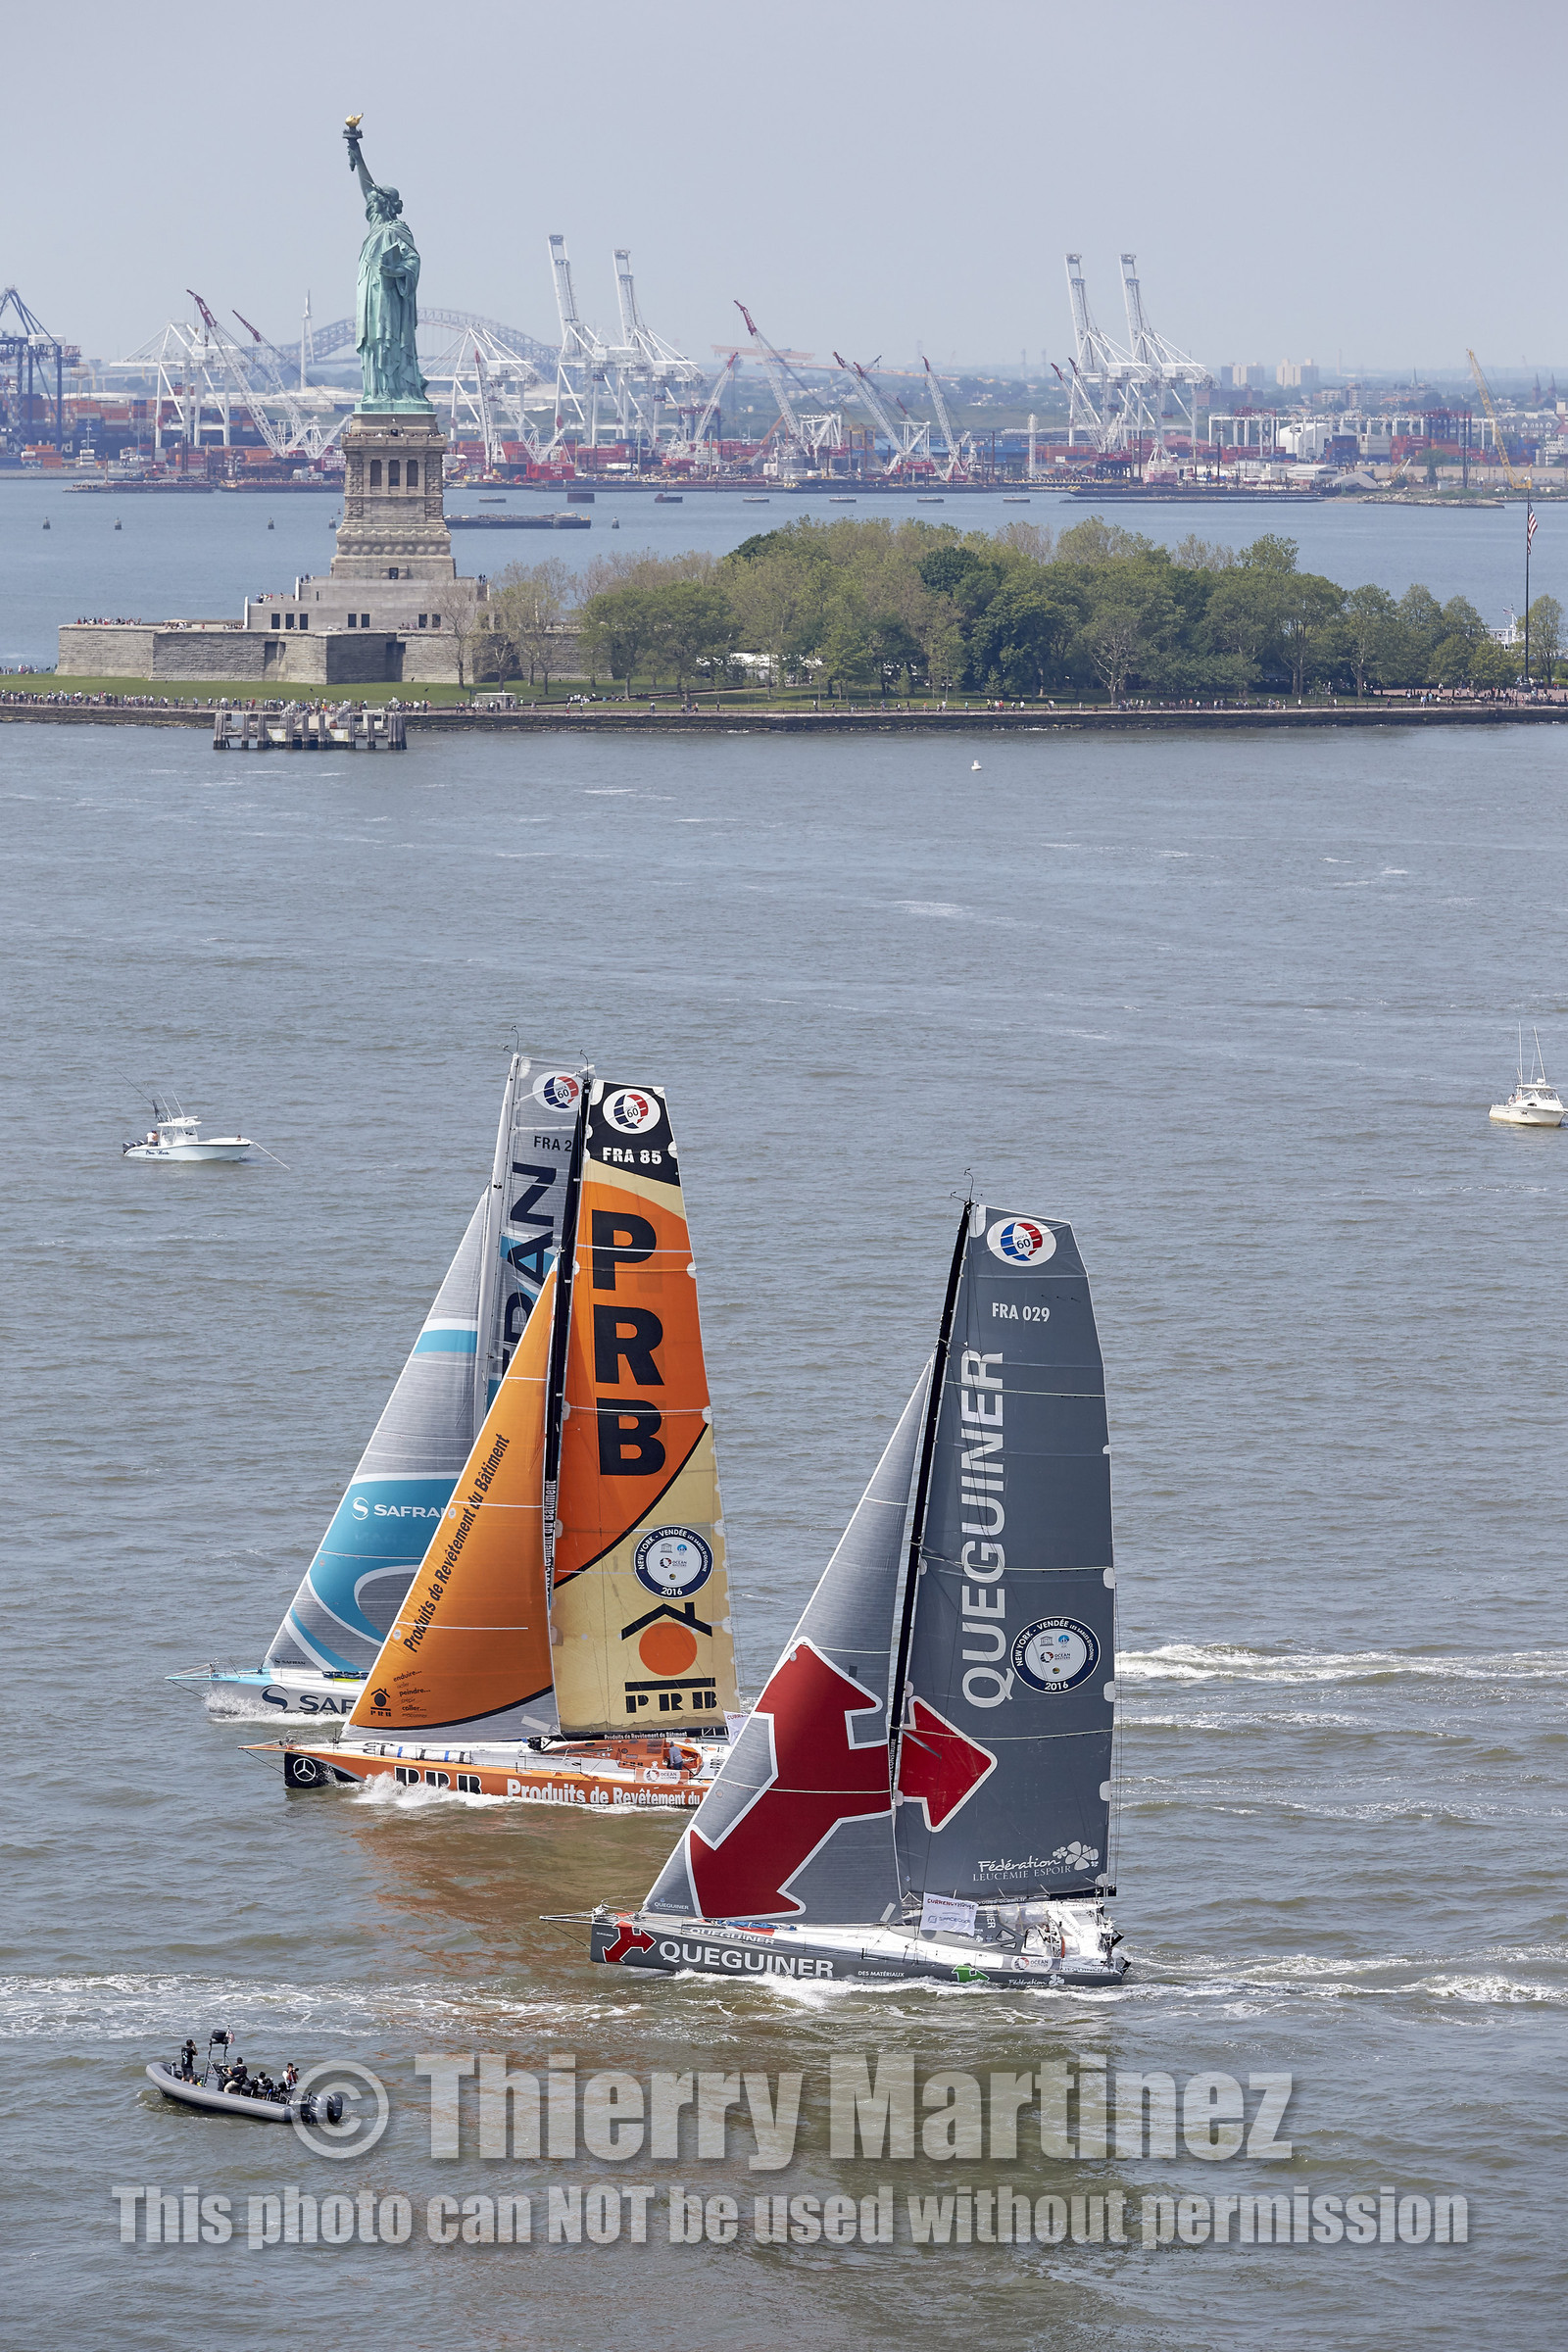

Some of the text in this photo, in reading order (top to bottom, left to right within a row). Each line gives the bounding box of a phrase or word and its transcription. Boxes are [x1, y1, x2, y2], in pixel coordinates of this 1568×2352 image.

[558, 1089, 569, 1099] 60
[626, 1107, 639, 1118] 60
[533, 1135, 561, 1151] FRA
[602, 1147, 662, 1165] FRA 85
[1016, 1238, 1031, 1250] 60
[992, 1301, 1051, 1323] FRA 029
[473, 1433, 510, 1493] Bâtiment
[467, 1491, 484, 1510] du
[659, 1529, 688, 1538] VENDÉE
[960, 1348, 1014, 1708] QUEGUINER
[434, 1507, 476, 1585] Revêtement
[639, 1536, 656, 1553] YORK
[637, 1553, 646, 1570] NEW
[427, 1583, 444, 1602] de
[661, 1588, 683, 1596] 2016
[403, 1600, 436, 1653] Produits
[1036, 1618, 1069, 1630] VENDÉE
[1017, 1630, 1033, 1649] YORK
[1014, 1649, 1024, 1667] NEW
[1044, 1682, 1069, 1690] 2016
[625, 1690, 717, 1714] PRB
[507, 1778, 587, 1803] Produits
[589, 1786, 610, 1804] de
[612, 1787, 686, 1805] Revêtement
[687, 1790, 701, 1805] du
[977, 1855, 1061, 1872] Fédération
[972, 1865, 1072, 1882] LEUCÉMIE ESPOIR
[654, 1901, 689, 1910] QUEGUINER
[688, 1927, 776, 1945] QUEGUINER
[659, 1940, 834, 1978] QUEGUINER
